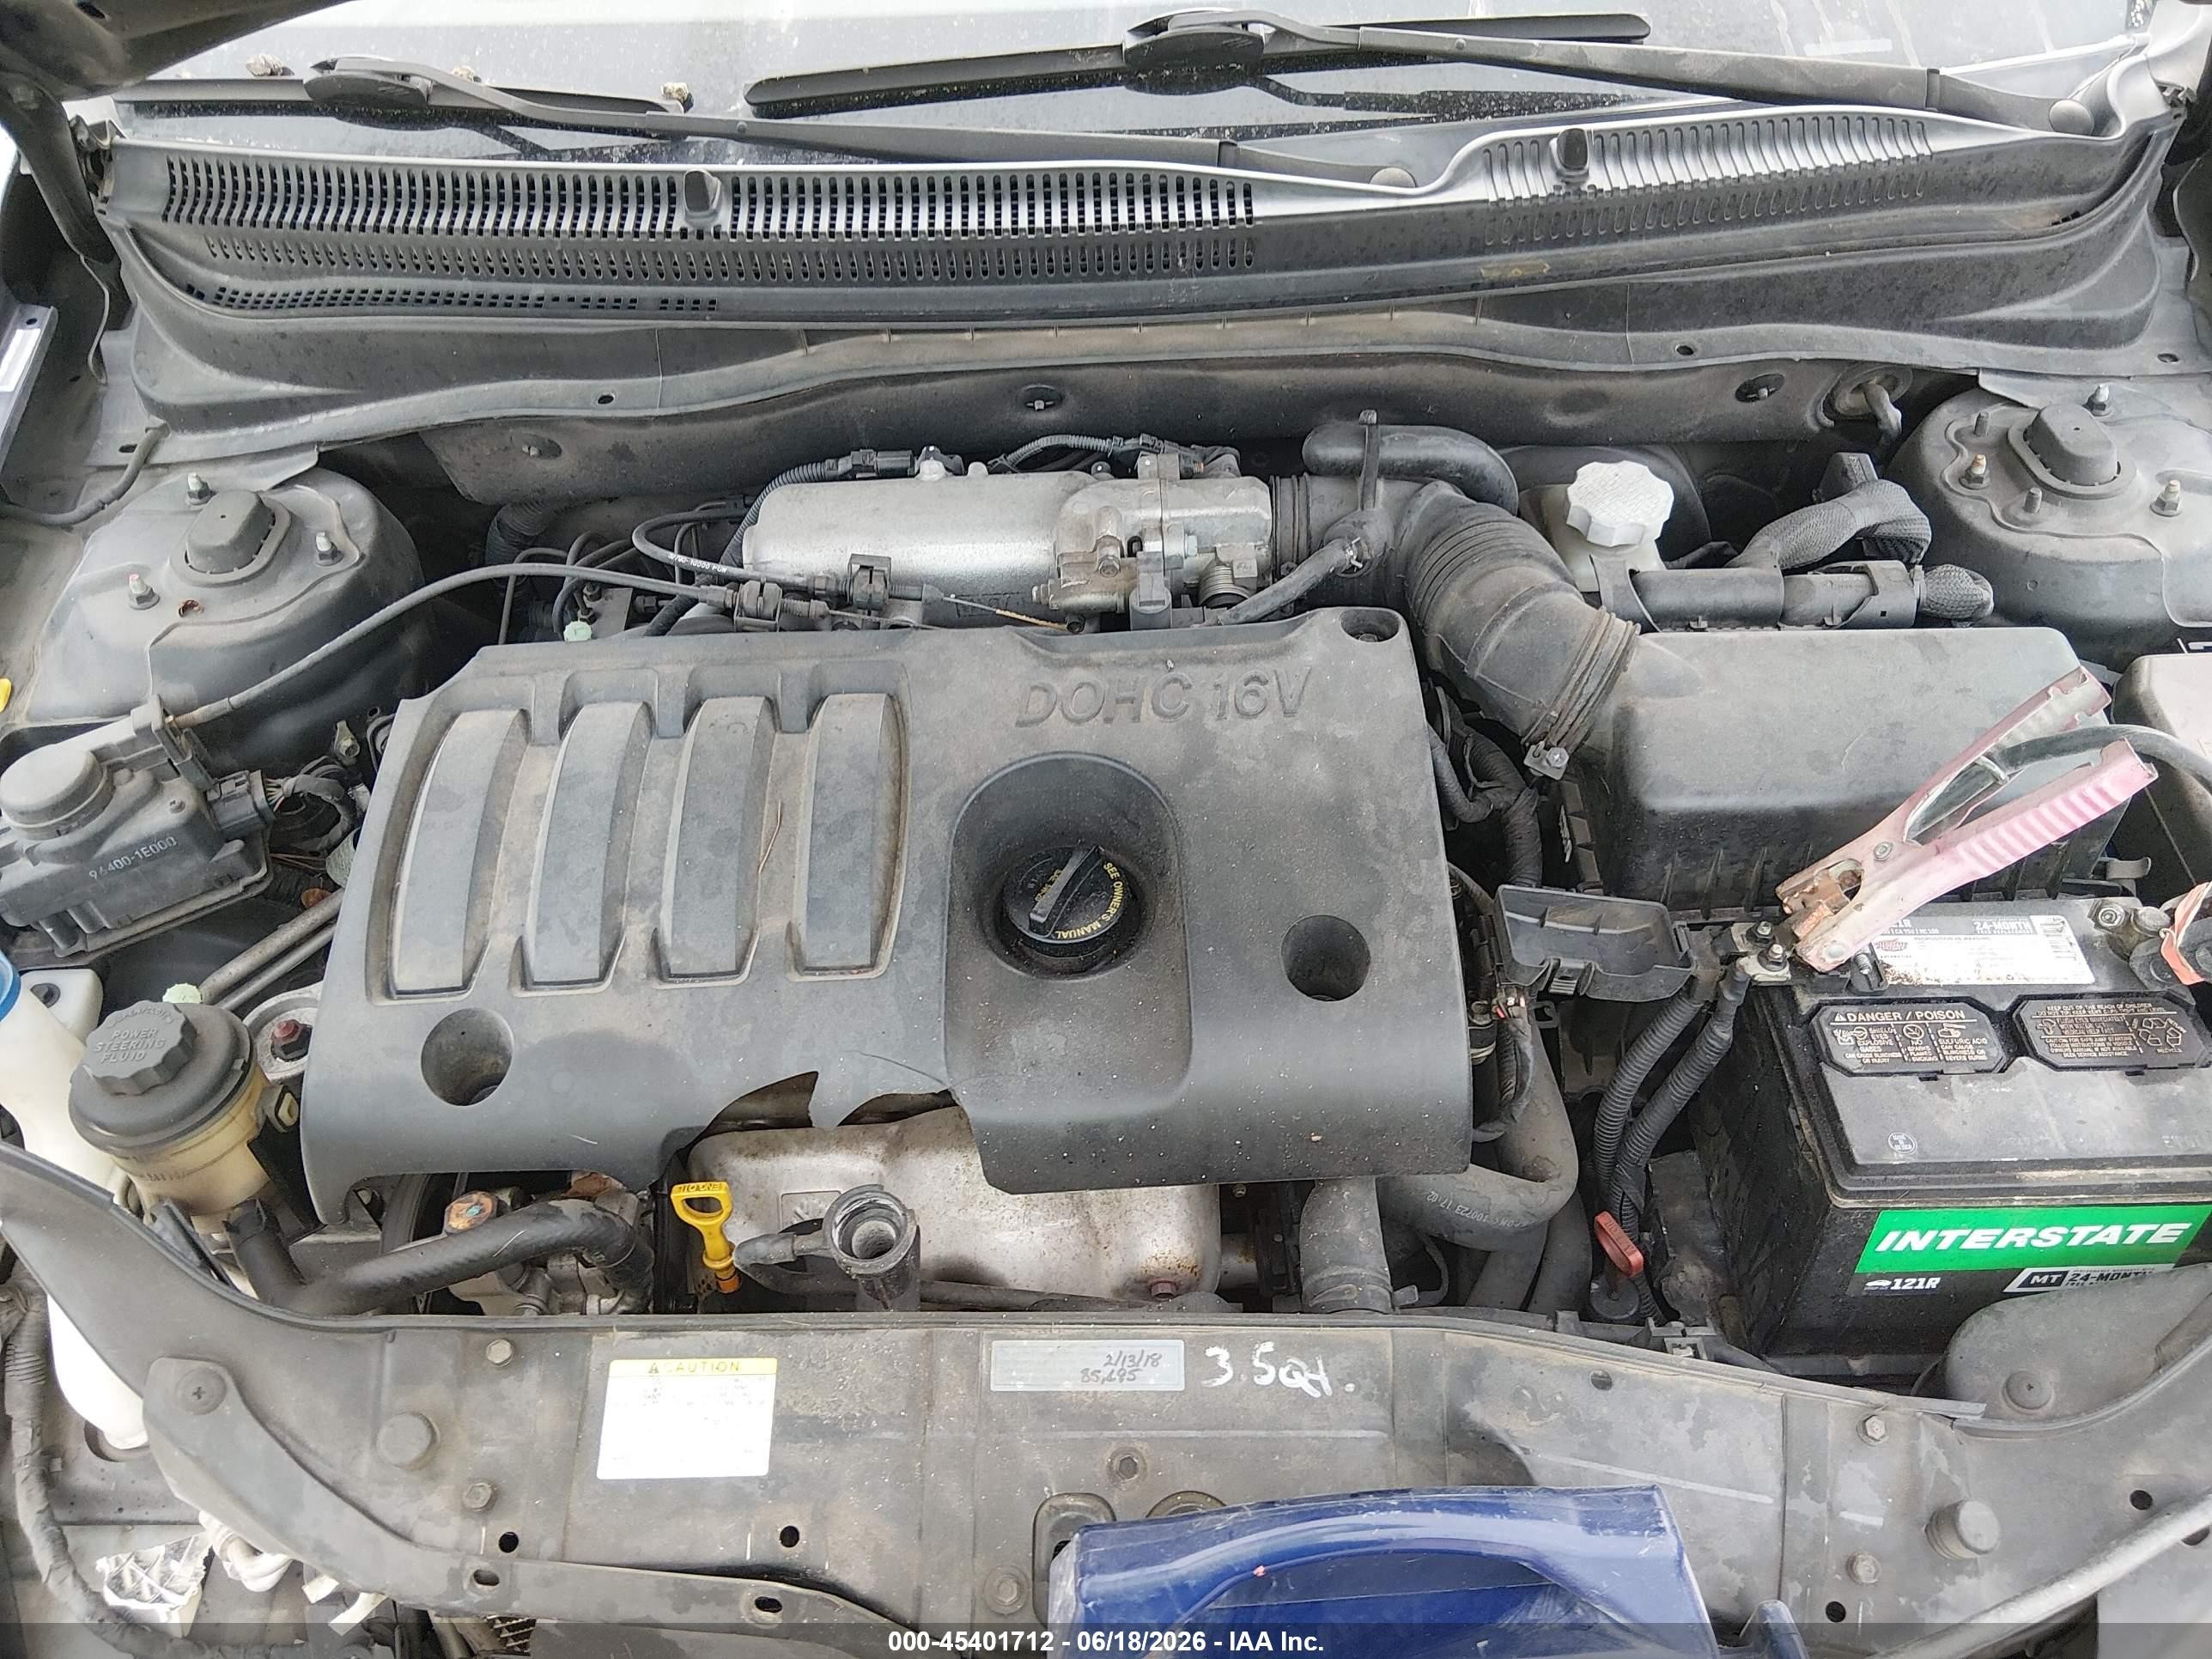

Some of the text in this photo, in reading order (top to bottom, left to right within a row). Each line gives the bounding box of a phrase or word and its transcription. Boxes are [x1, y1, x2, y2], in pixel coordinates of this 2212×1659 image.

[1015, 665, 1312, 727] DOHC 16V
[1055, 862, 1124, 939] SEE OWNER'S MANUAL
[1846, 1012, 1903, 1022] DANGER
[1915, 1010, 1966, 1020] POISON
[111, 1029, 158, 1040] POWER
[94, 1038, 166, 1053] STEERING
[100, 1050, 146, 1064] FLUID
[1875, 1223, 2192, 1252] INTERSTATE
[1890, 1277, 1941, 1290] 121R
[2030, 1274, 2062, 1285] MT
[1103, 1349, 1163, 1368] 2/13/18
